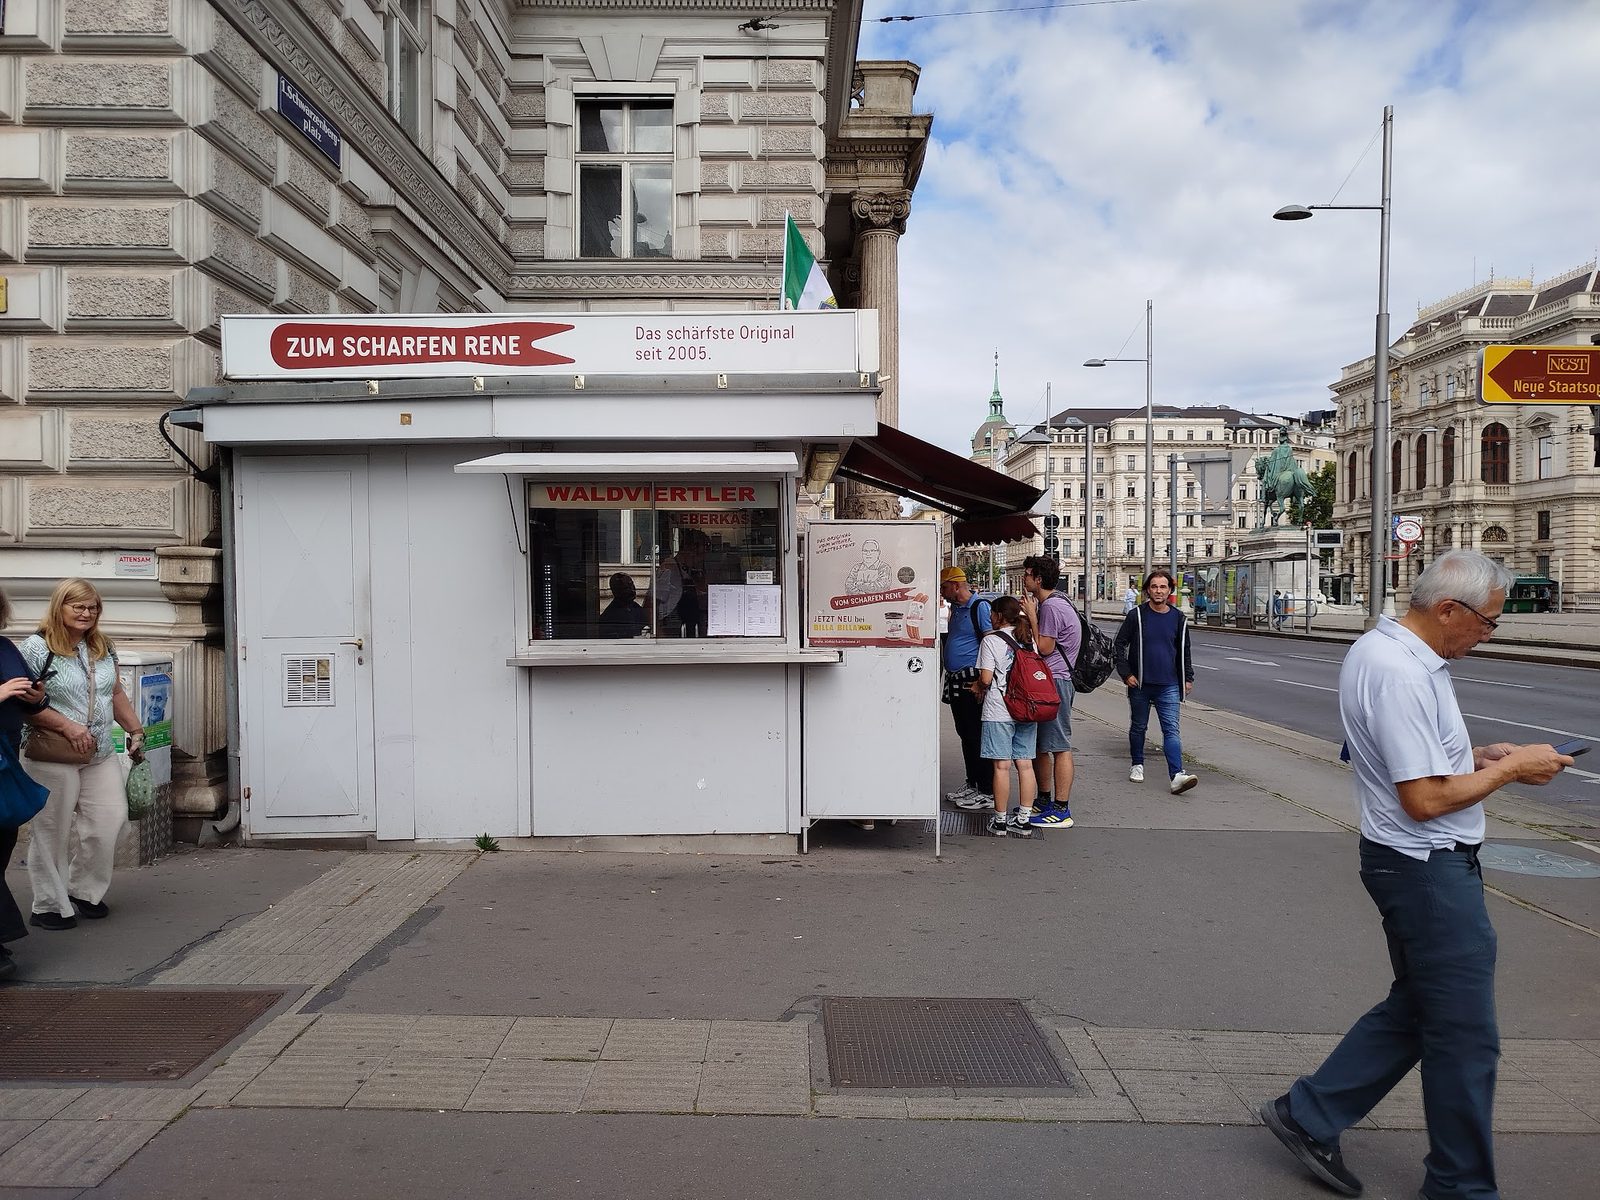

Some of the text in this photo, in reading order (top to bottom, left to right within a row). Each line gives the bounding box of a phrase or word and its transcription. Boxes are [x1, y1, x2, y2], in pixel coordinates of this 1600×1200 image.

[303, 119, 322, 142] platz
[635, 325, 795, 343] Das schärfste Original
[286, 335, 521, 357] ZUM SCHARFEN RENE
[635, 346, 712, 360] seit 2005.
[1549, 357, 1587, 371] NEST
[1513, 380, 1545, 393] Neue
[546, 486, 756, 502] WALDVIERTLER
[834, 592, 902, 607] VOM SCHARFEN RENE
[813, 615, 865, 623] JETZT NEU bei
